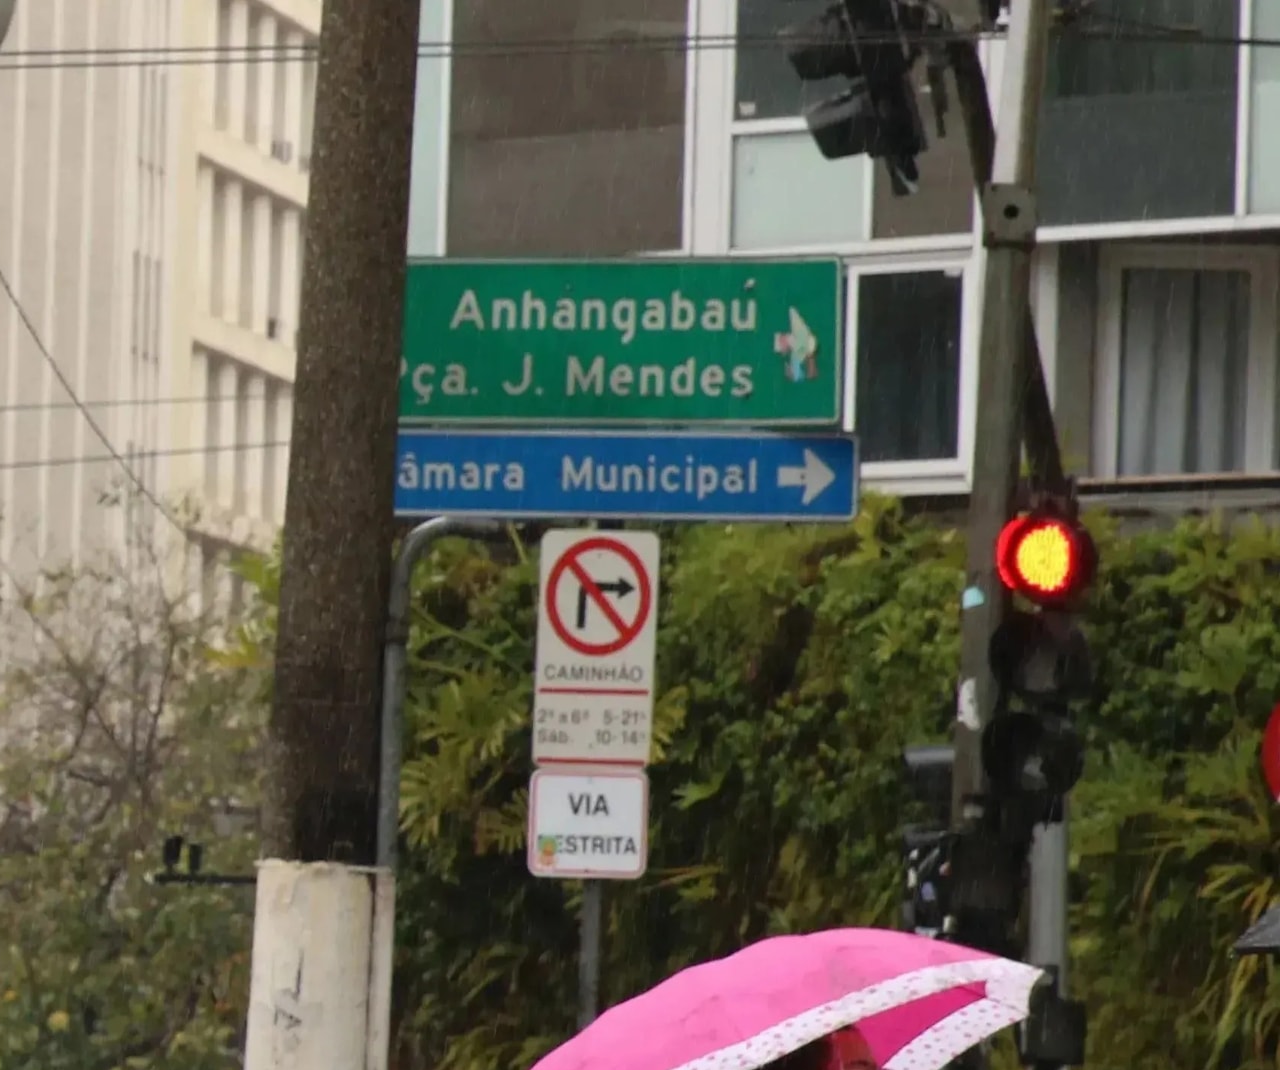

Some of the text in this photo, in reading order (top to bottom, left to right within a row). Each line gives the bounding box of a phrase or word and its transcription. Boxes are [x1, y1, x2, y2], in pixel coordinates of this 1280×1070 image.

[449, 279, 758, 344] Anhangabaú
[503, 354, 543, 397] J.
[566, 355, 755, 397] Mendes
[398, 452, 758, 500] âmara Municipal
[543, 662, 644, 682] CAMINHÃO
[568, 792, 609, 816] VIA
[538, 834, 637, 855] ESTRITA
